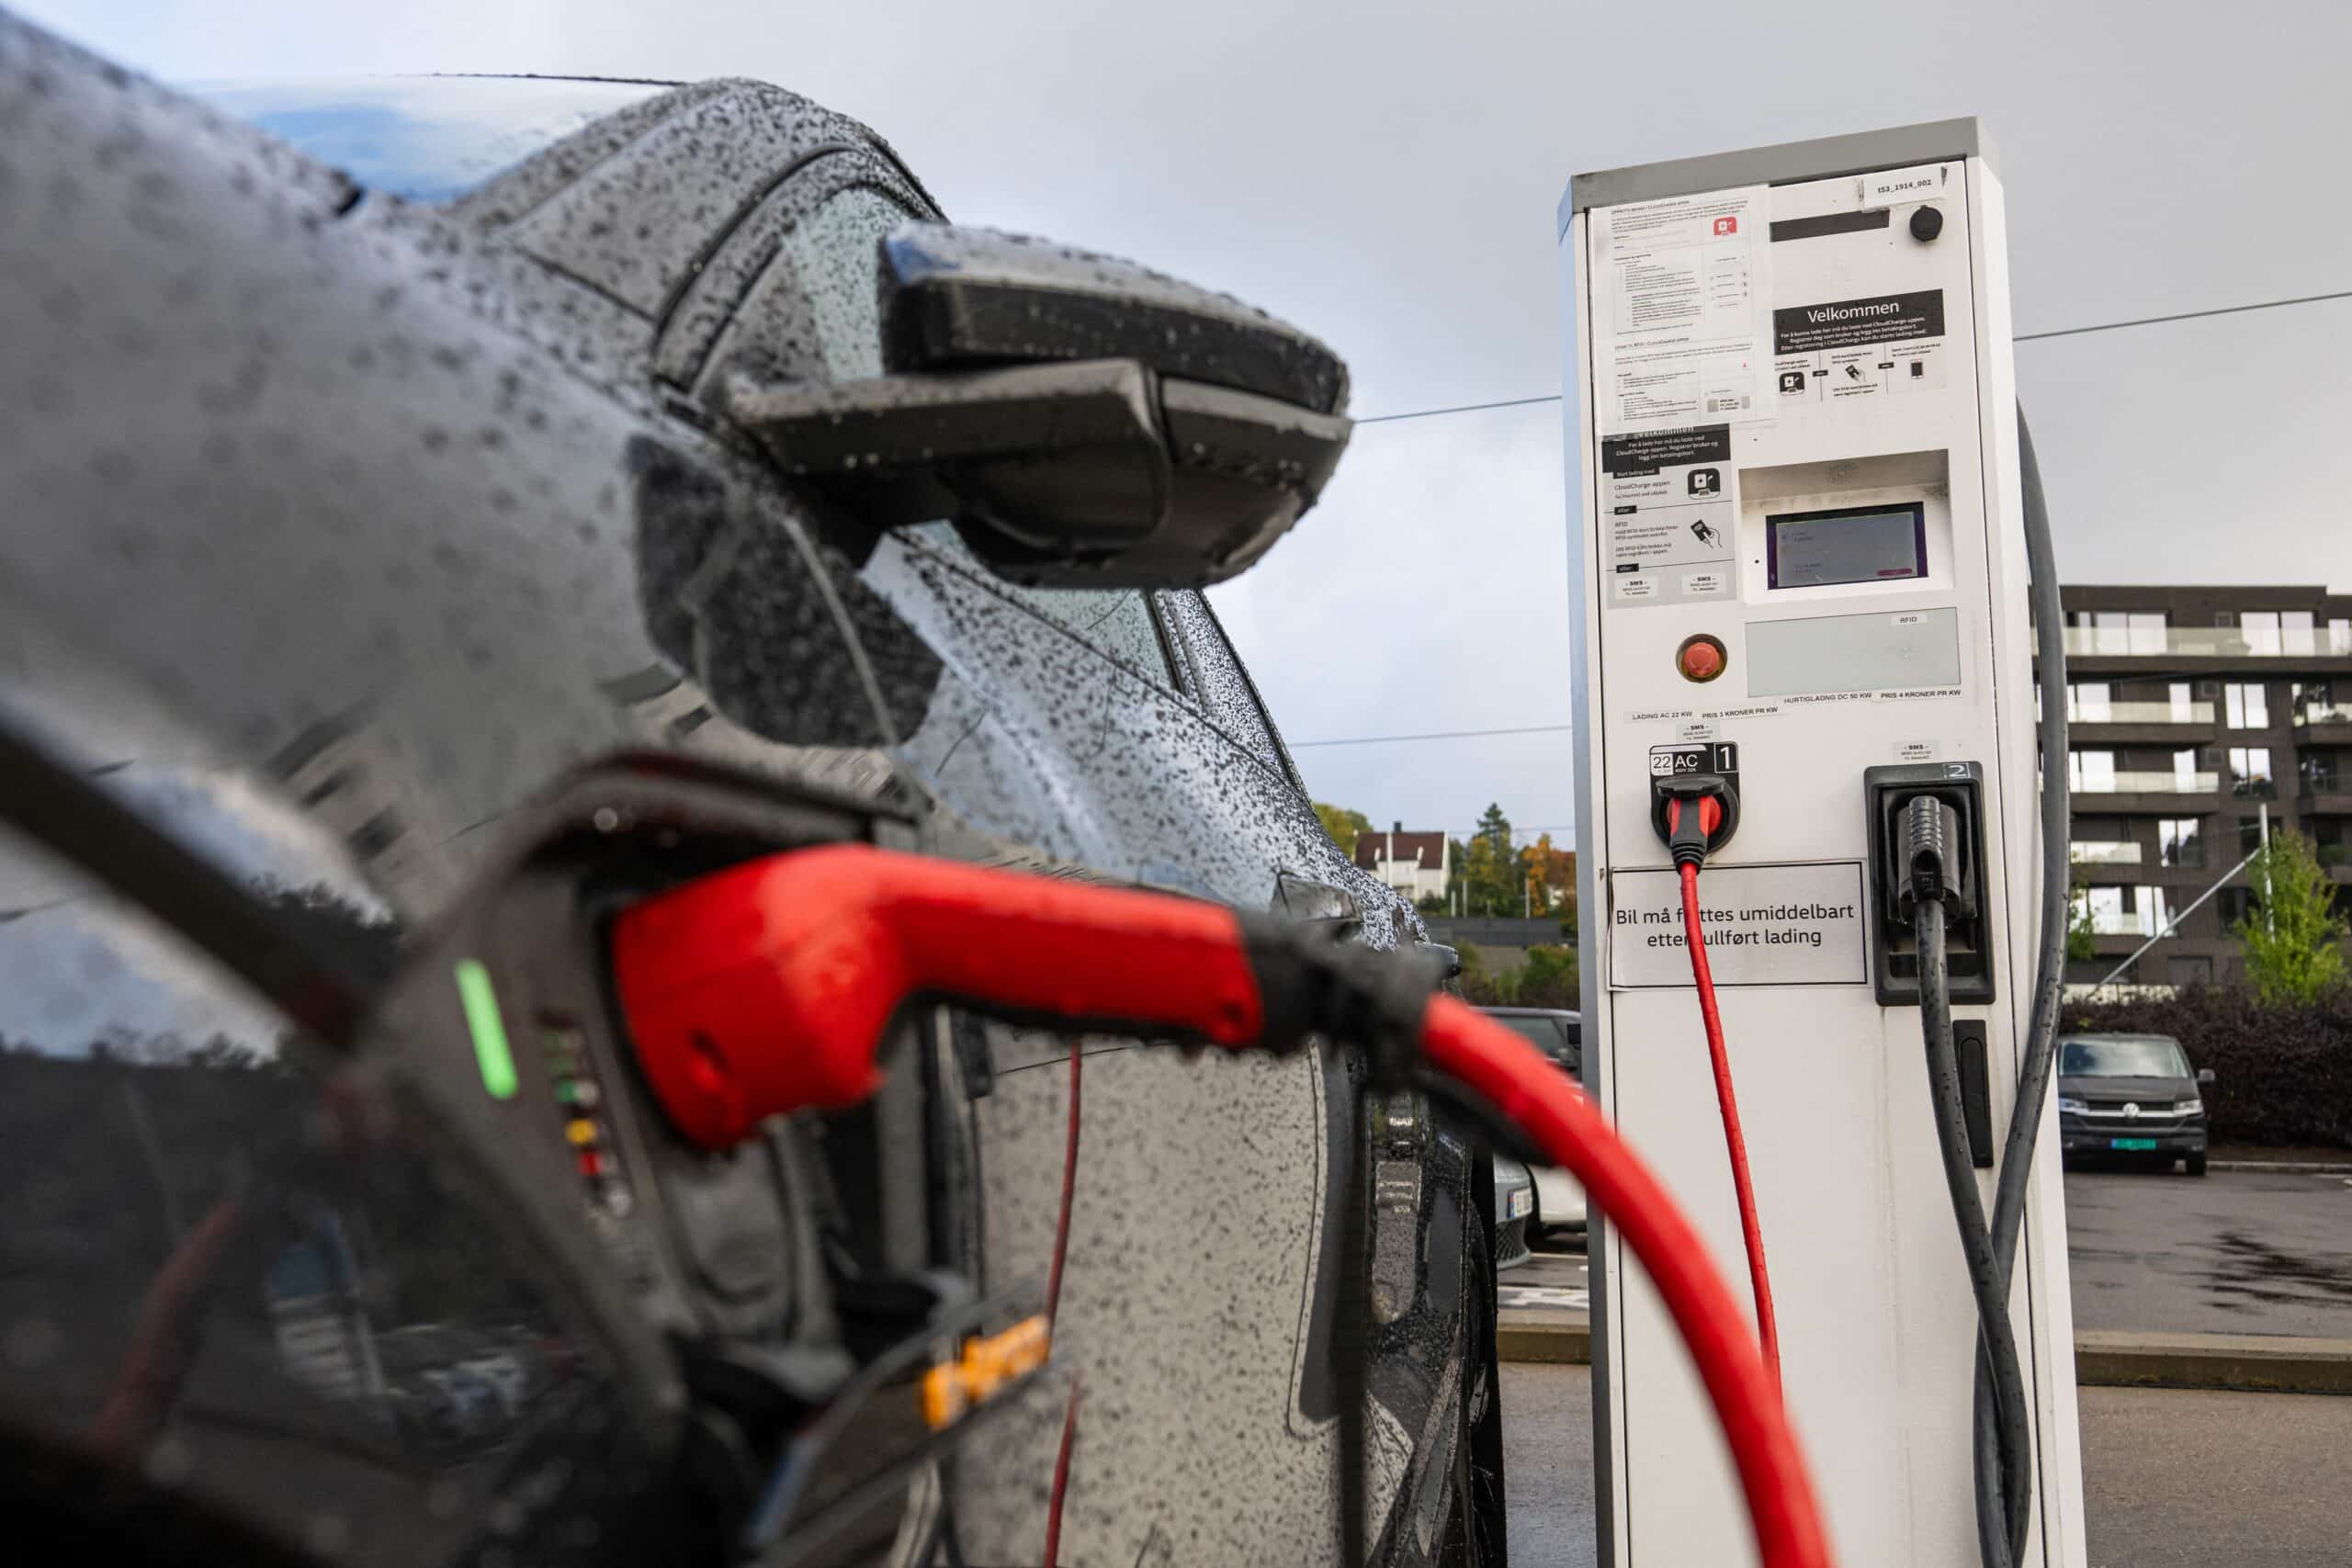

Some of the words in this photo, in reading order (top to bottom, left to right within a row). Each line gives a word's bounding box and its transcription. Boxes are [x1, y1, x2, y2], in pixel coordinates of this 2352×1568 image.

[1807, 302, 1900, 322] Velkommen
[1653, 756, 1670, 768] 22
[1675, 754, 1698, 768] AC
[1720, 746, 1731, 770] 1
[1949, 765, 1967, 777] 2
[1616, 910, 1637, 924] Bil
[1644, 908, 1670, 923] må
[1676, 908, 1734, 922] fttes
[1740, 904, 1854, 921] umiddelbart
[1702, 930, 1759, 945] ullført
[1766, 929, 1821, 946] lading
